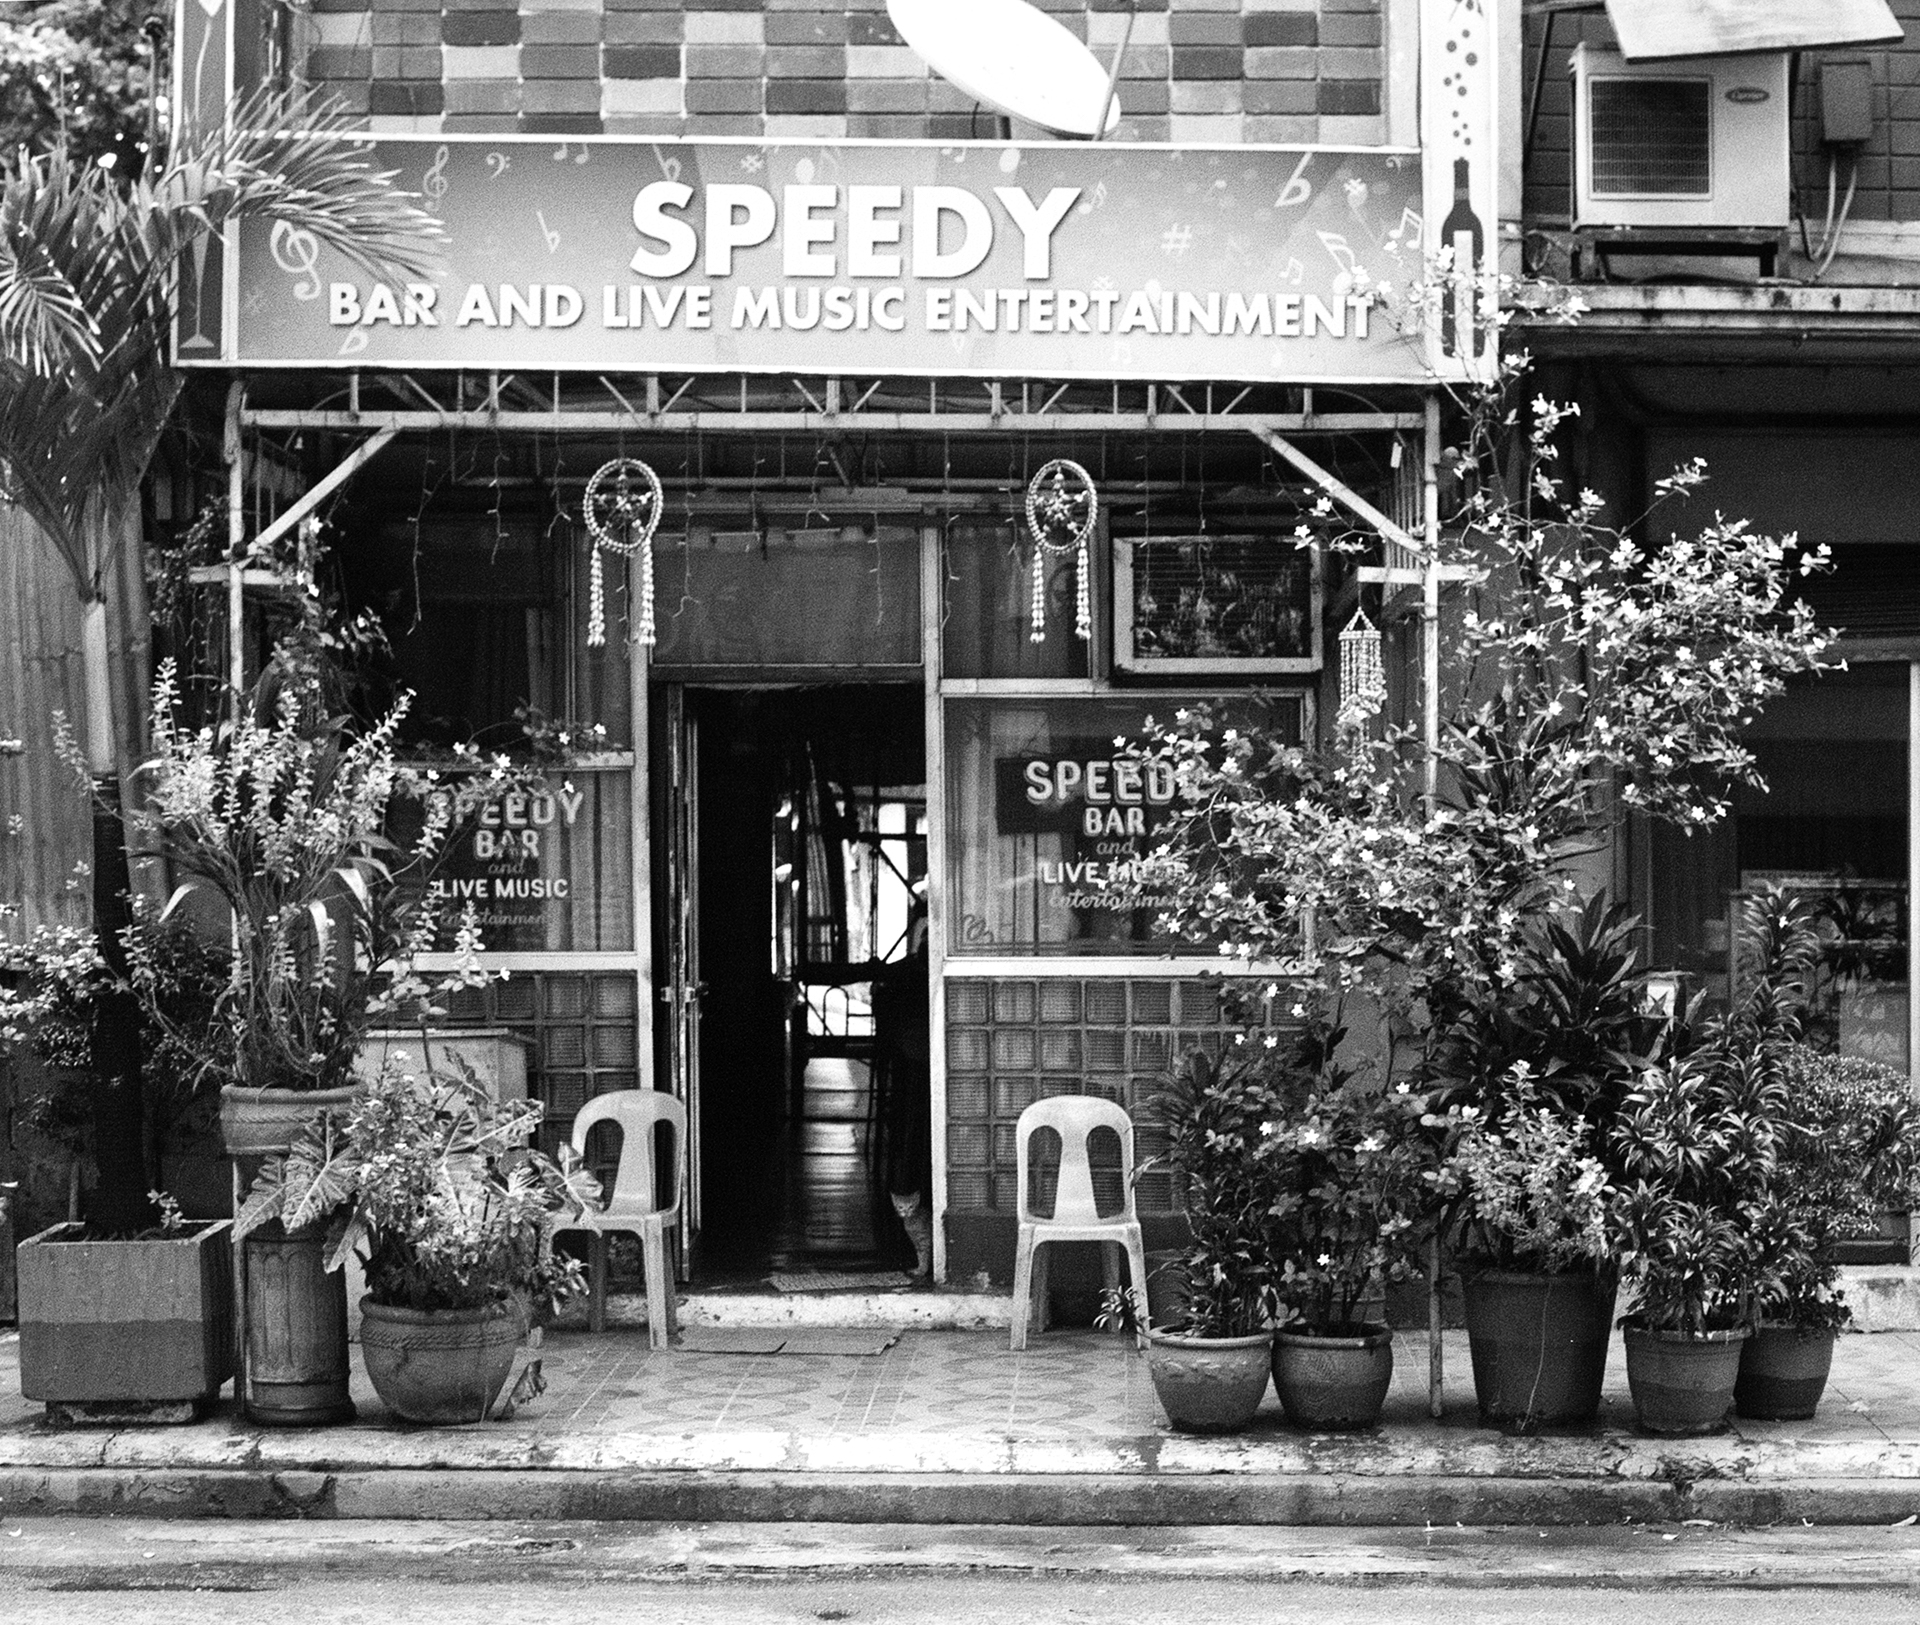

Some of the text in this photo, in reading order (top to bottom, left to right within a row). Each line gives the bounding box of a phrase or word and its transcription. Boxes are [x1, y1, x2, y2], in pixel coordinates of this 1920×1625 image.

[630, 181, 1081, 281] SPEEDY
[329, 282, 1374, 338] BAR AND LIVE MUSIC ENTERTAINMENT
[1024, 760, 1188, 804] SPEED
[429, 790, 584, 828] PEEDY
[1084, 806, 1146, 837] BAR
[474, 829, 540, 860] BAR
[1096, 836, 1136, 855] and
[488, 857, 526, 874] and
[1043, 861, 1100, 884] LIVE
[439, 878, 568, 899] LIVE MUSIC
